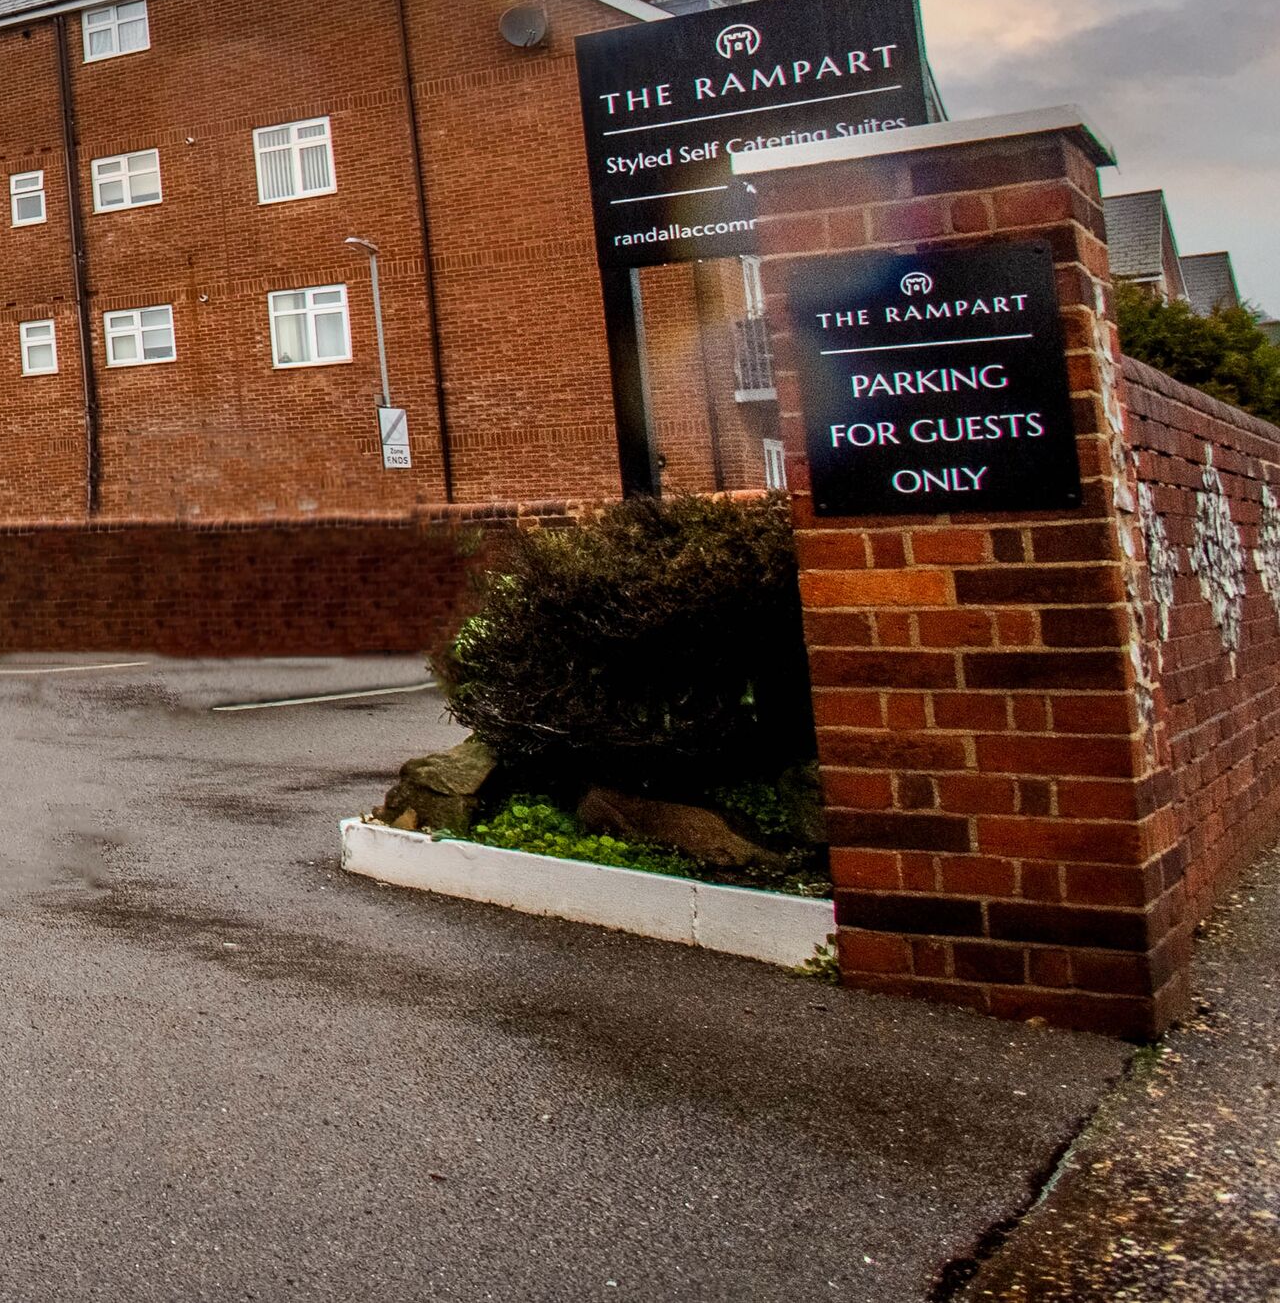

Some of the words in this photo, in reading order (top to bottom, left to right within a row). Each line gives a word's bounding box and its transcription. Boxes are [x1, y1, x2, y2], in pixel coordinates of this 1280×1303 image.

[599, 84, 672, 114] THE
[694, 44, 897, 100] RAMPART
[606, 148, 673, 176] Styled
[680, 141, 720, 164] Self
[817, 309, 870, 329] THE
[886, 294, 1028, 324] RAMPART
[851, 364, 1009, 398] PARKING
[830, 421, 900, 448] FOR
[910, 413, 1044, 443] GUESTS
[387, 456, 408, 464] ENDS
[892, 466, 989, 494] ONLY
